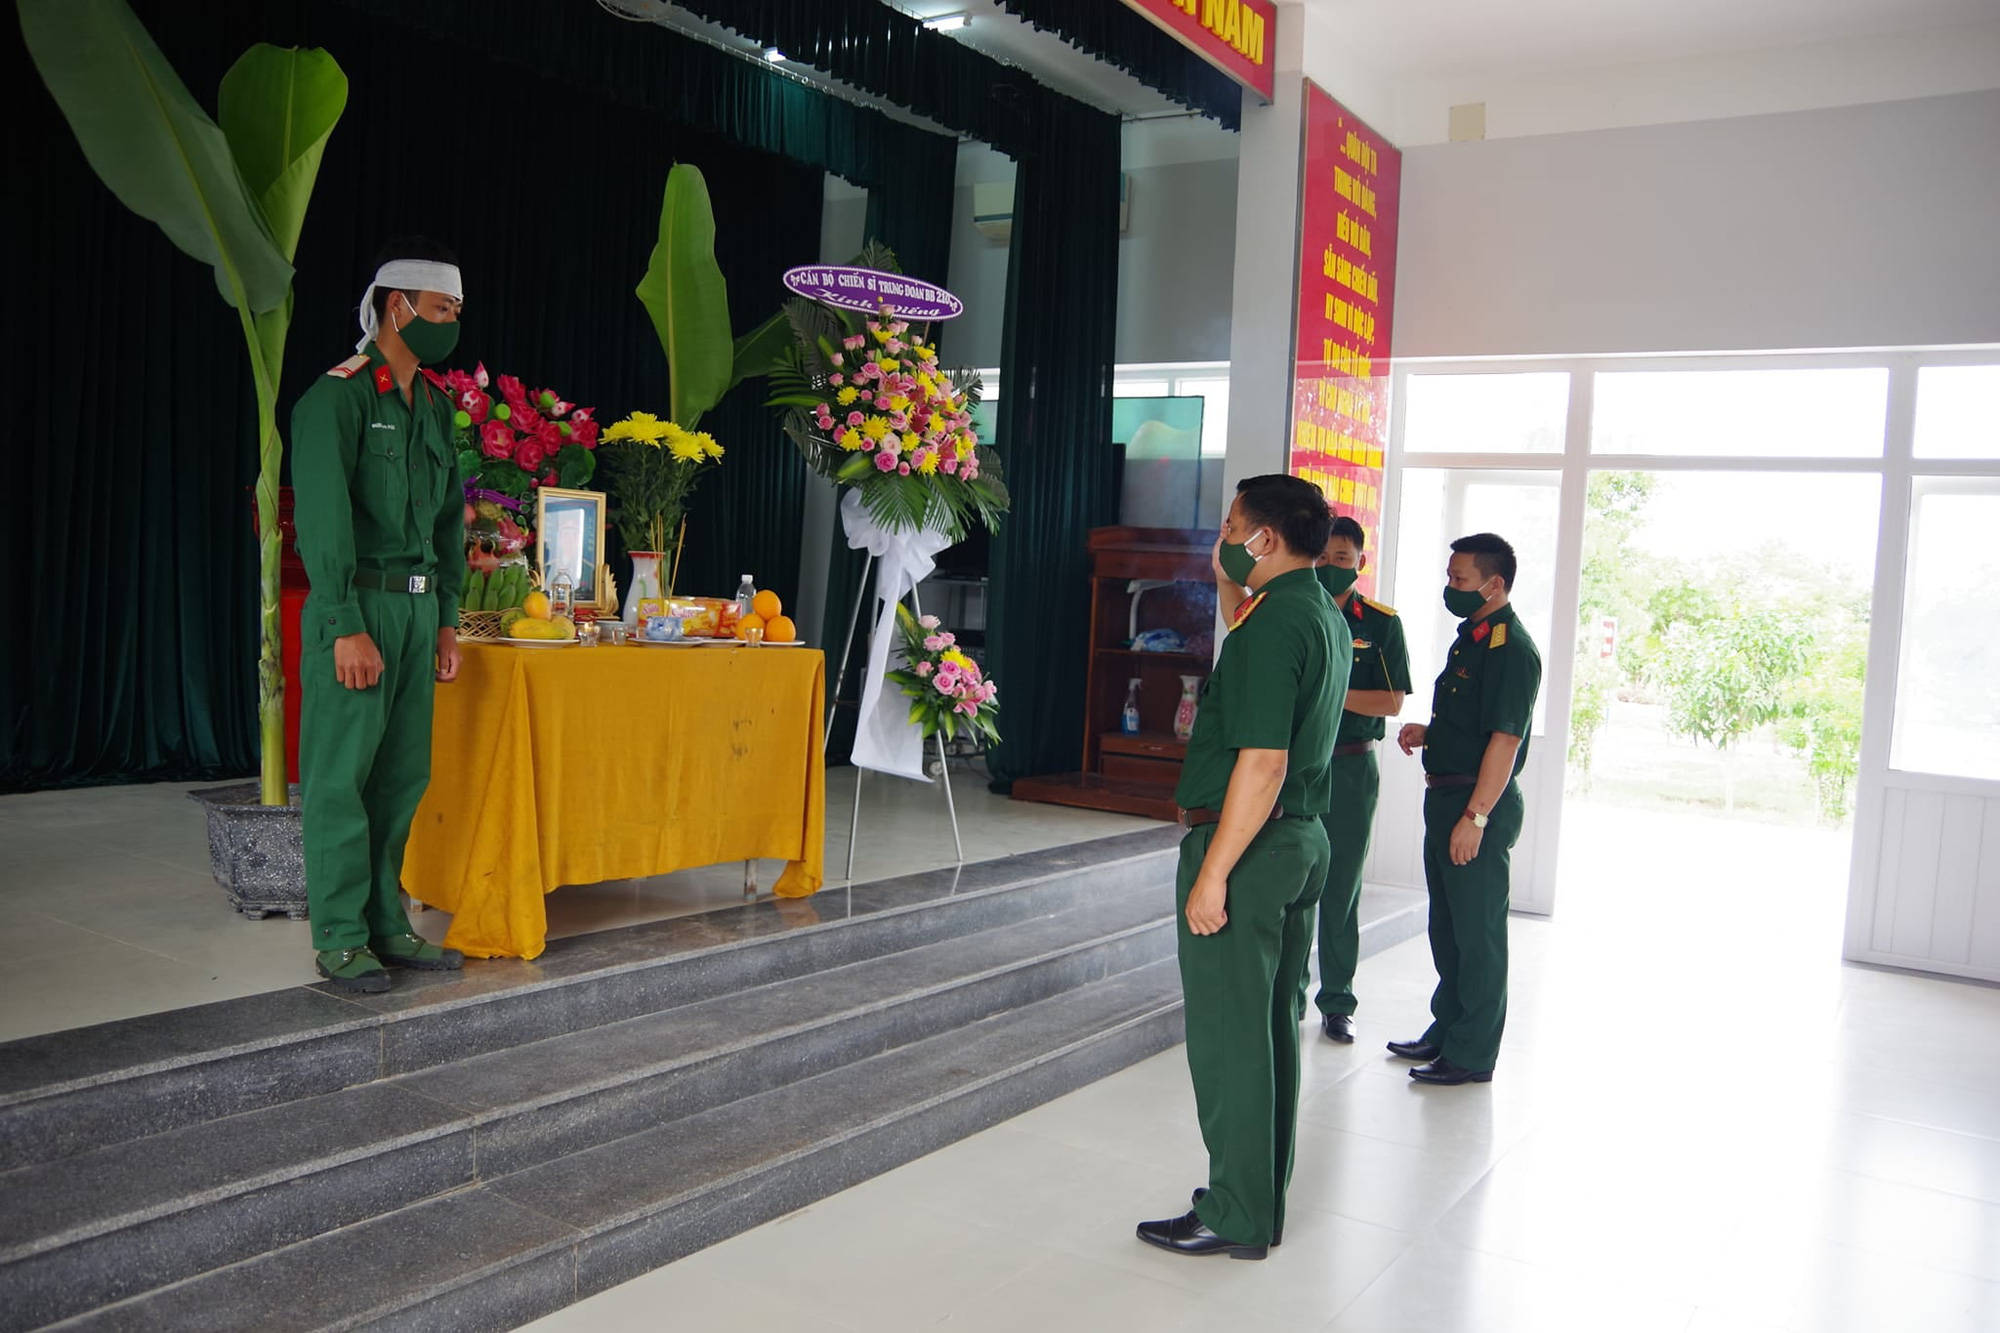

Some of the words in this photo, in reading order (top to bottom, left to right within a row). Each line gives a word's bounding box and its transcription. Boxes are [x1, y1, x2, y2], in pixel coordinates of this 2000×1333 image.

[1201, 0, 1265, 66] NAM
[800, 270, 819, 286] CÁN
[822, 270, 834, 287] BỘ
[838, 272, 864, 288] CHIẾN
[878, 281, 904, 296] TRUNG
[925, 289, 936, 302] BB
